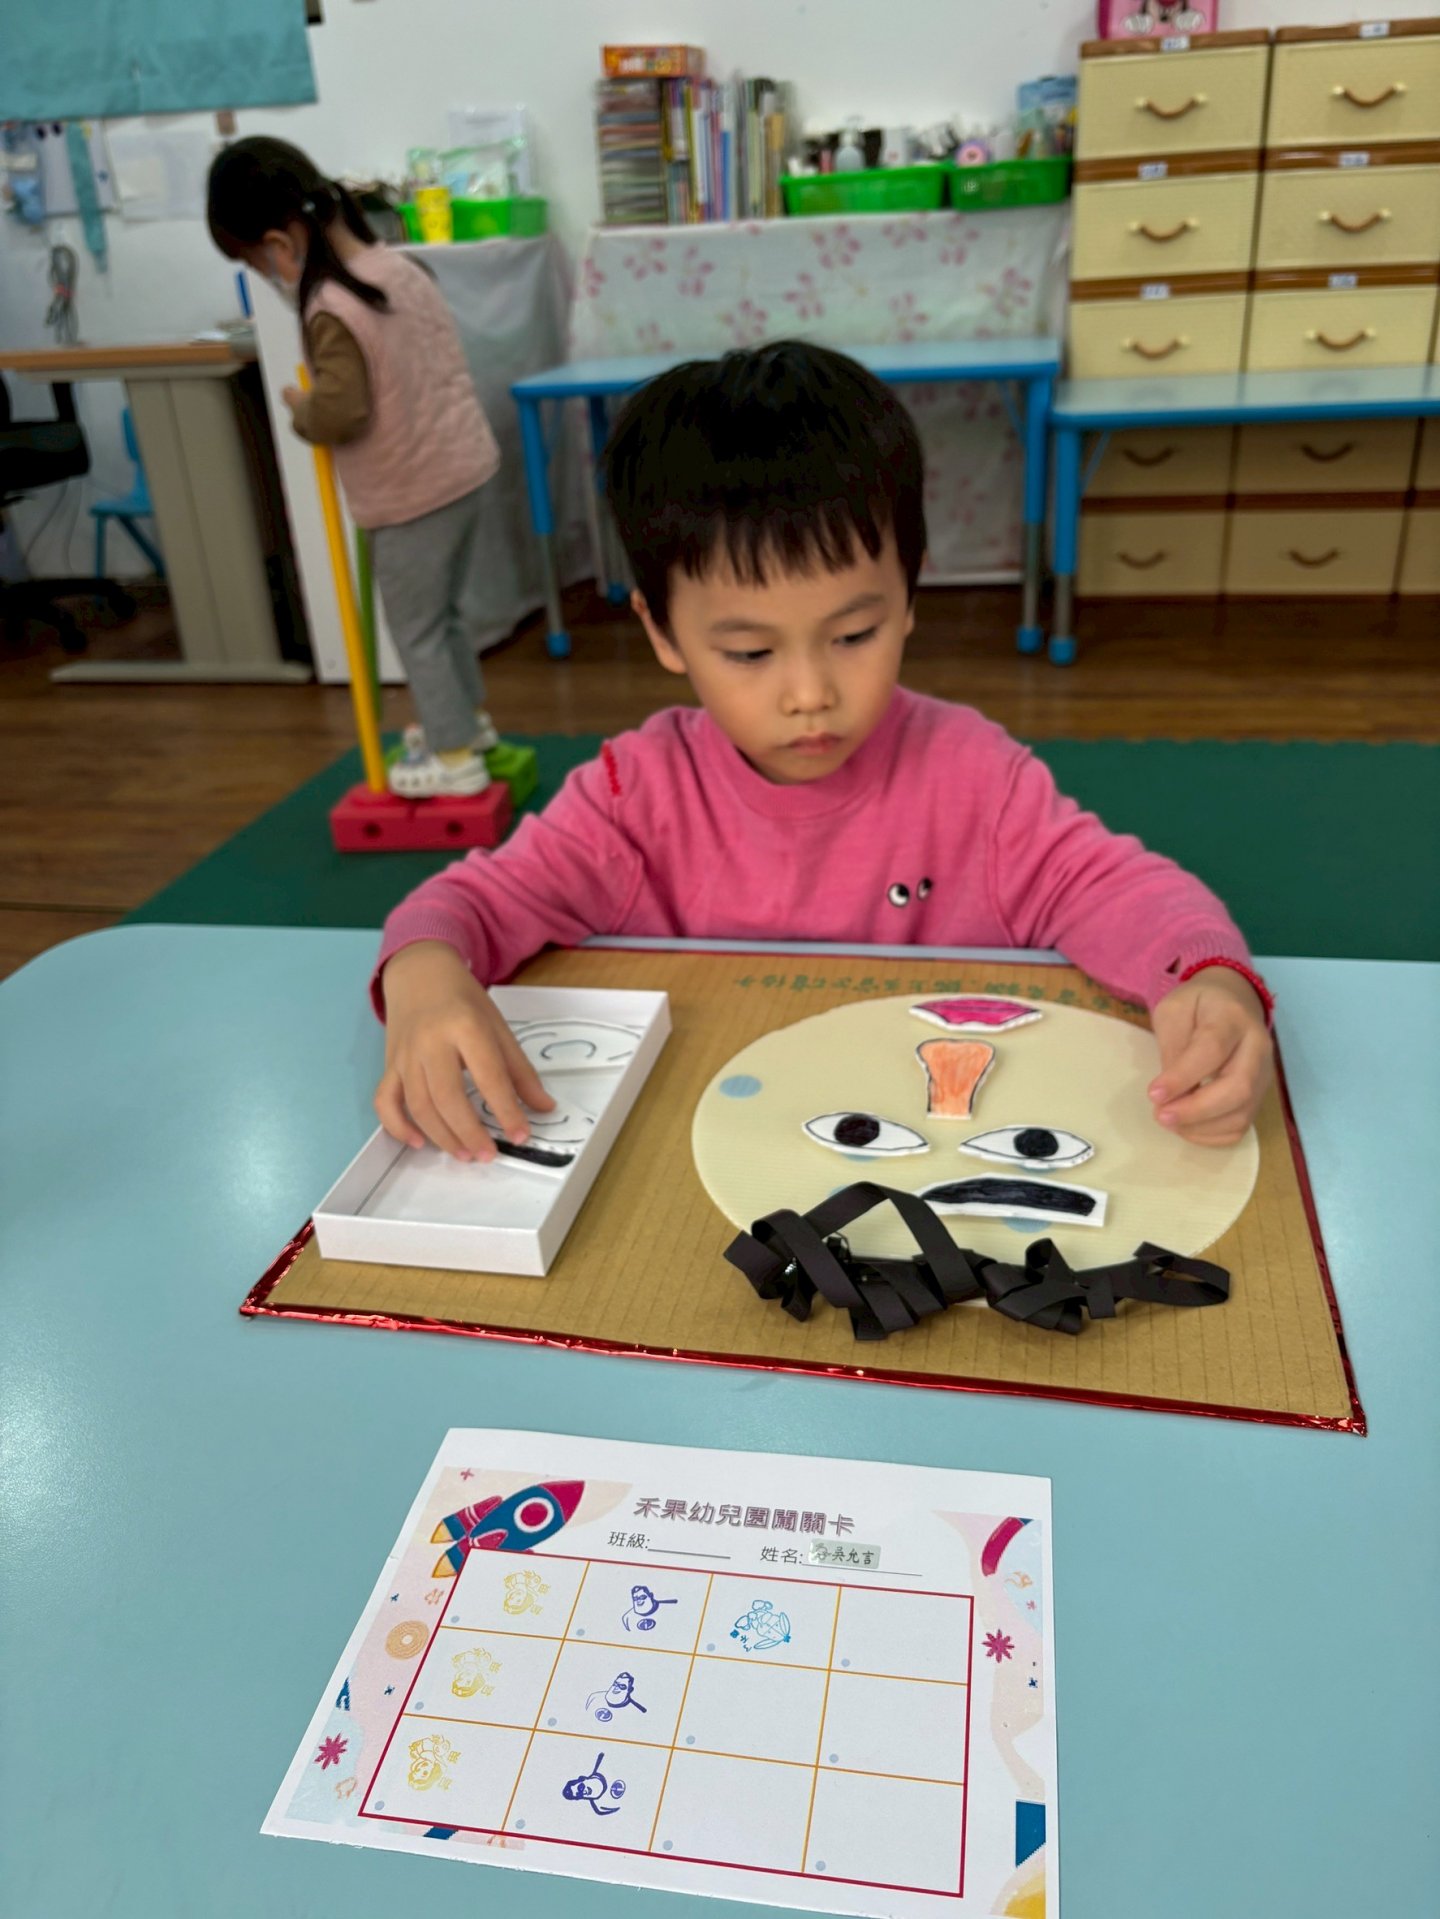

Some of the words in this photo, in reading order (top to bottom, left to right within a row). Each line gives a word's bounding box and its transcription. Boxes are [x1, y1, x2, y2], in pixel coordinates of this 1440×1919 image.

[633, 1497, 856, 1536] 禾果幼兒園闖關卡
[607, 1531, 651, 1550] 班級:
[760, 1546, 803, 1565] 姓名:
[831, 1546, 875, 1565] 吳允言
